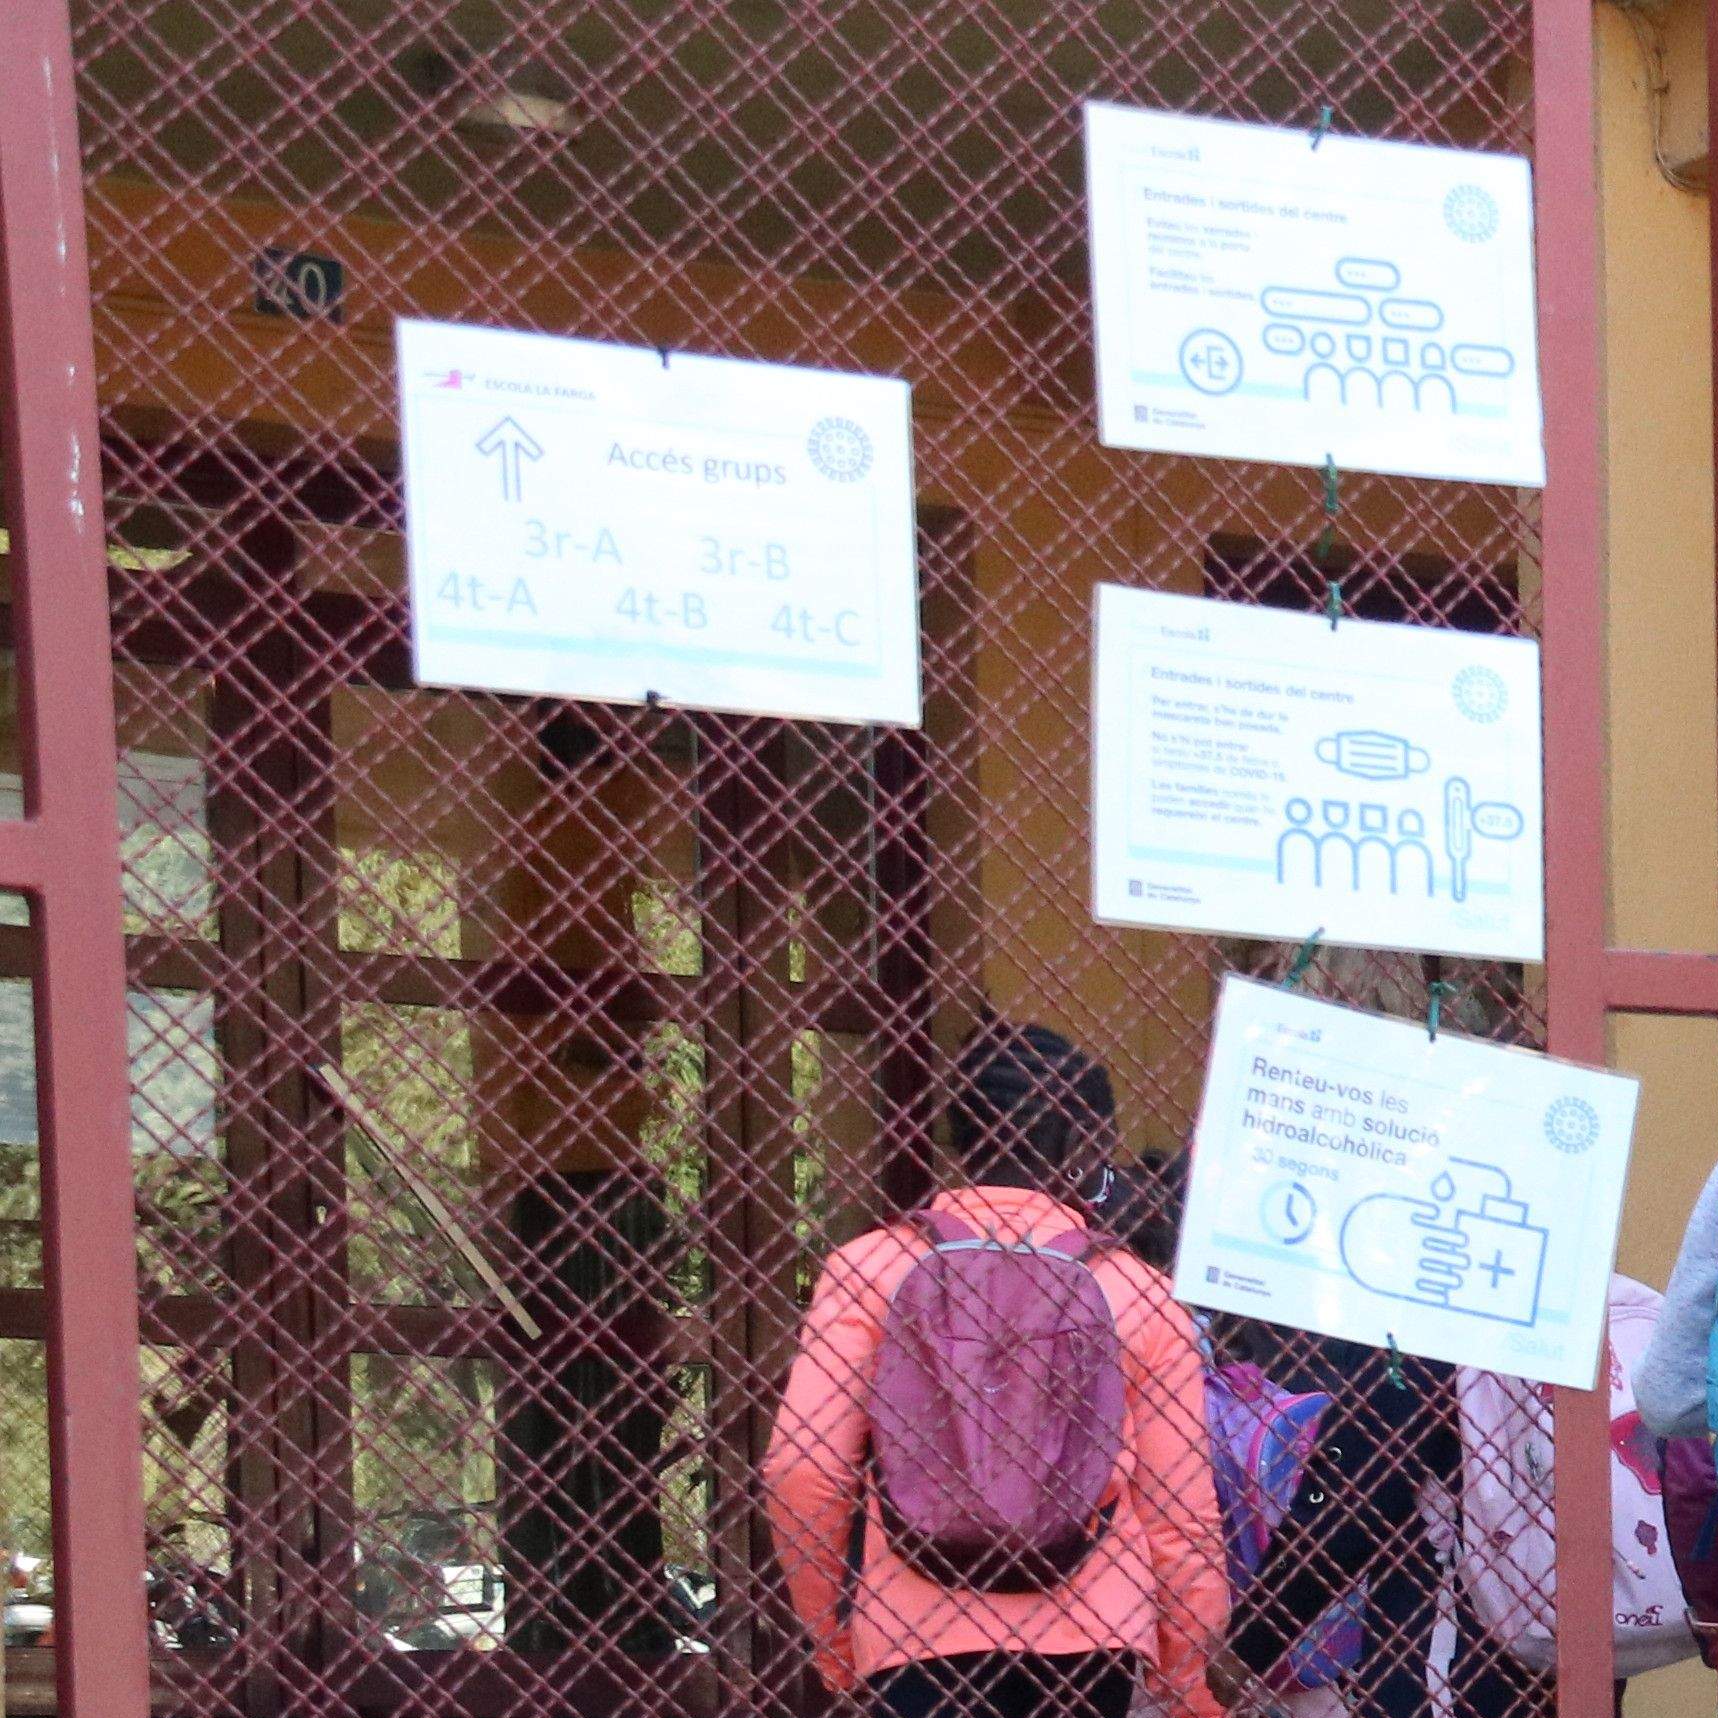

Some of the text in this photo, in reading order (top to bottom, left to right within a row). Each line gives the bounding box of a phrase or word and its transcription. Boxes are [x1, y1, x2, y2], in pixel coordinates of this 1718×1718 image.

[485, 378, 533, 395] ESCOLA
[607, 441, 788, 490] Accés grups
[523, 517, 793, 583] 3r-A 3r-B
[437, 569, 863, 648] 4t-A 4t-B 4t-C
[1151, 666, 1212, 686] Entrades
[1225, 678, 1280, 695] sortides
[1286, 684, 1306, 698] del
[1310, 689, 1354, 704] centre
[1252, 1056, 1409, 1115] Renteu-vos les
[1242, 1109, 1408, 1167] hidroalcohòlica
[1248, 1086, 1441, 1148] mans amb solució
[1252, 1146, 1340, 1182] 30 segons
